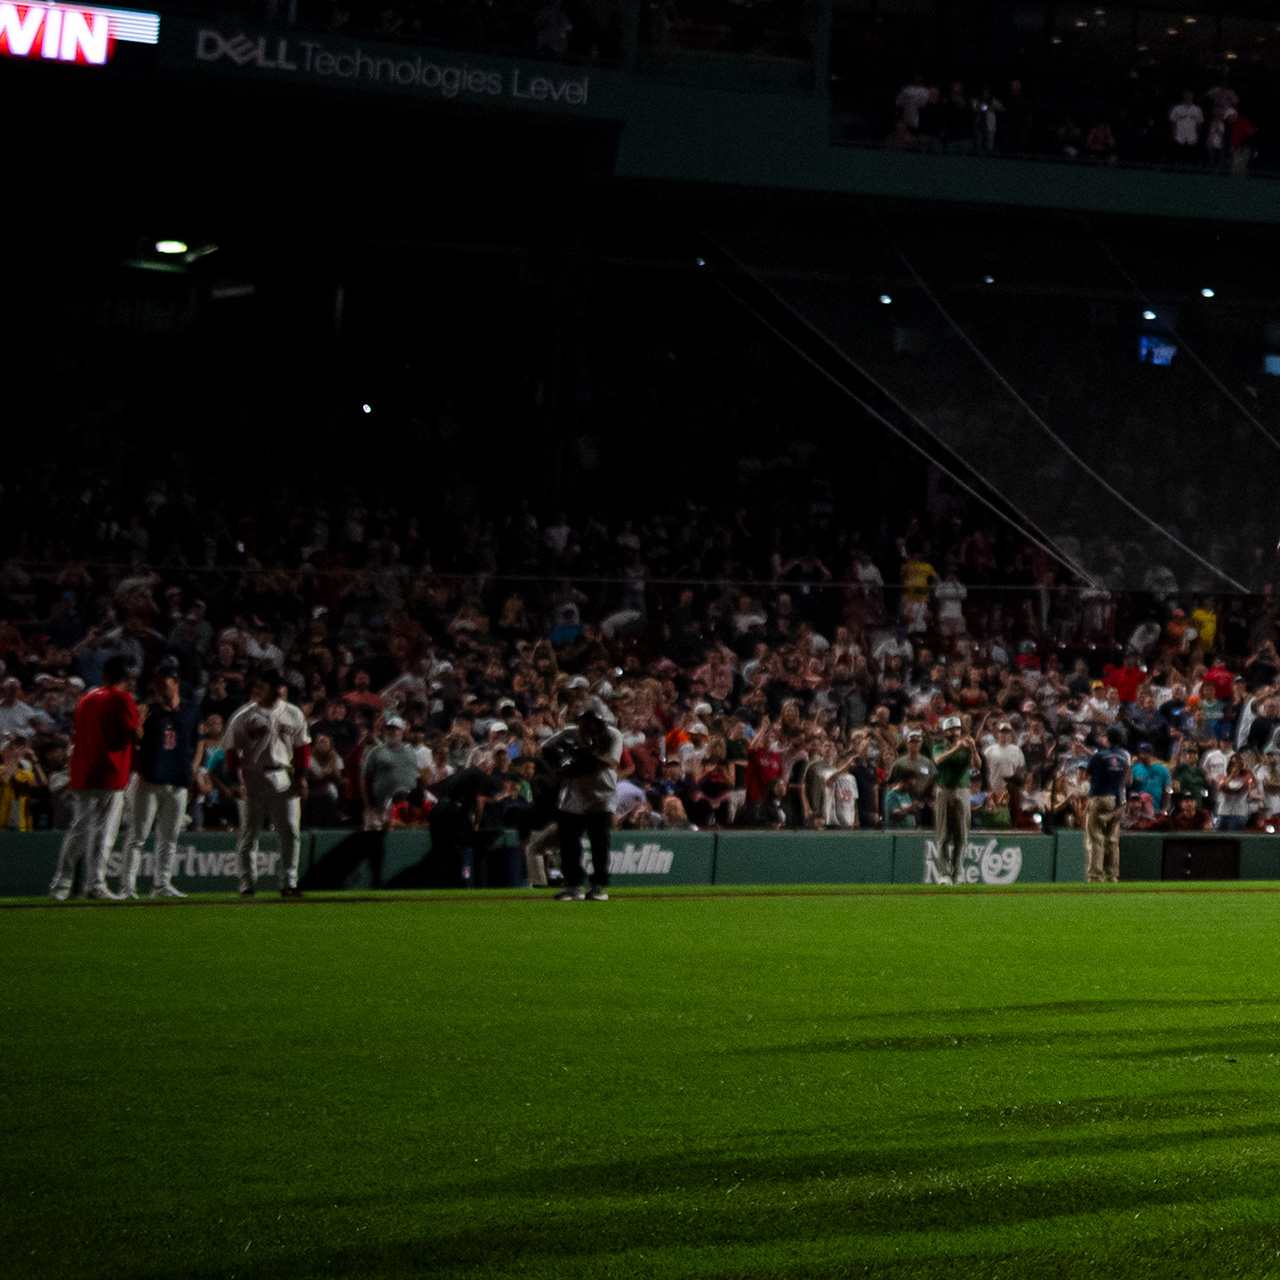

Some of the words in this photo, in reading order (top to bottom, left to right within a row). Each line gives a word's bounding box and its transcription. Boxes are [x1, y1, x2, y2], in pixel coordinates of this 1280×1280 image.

[196, 28, 297, 71] DELL
[300, 40, 501, 98] Technologies
[512, 68, 589, 104] Level
